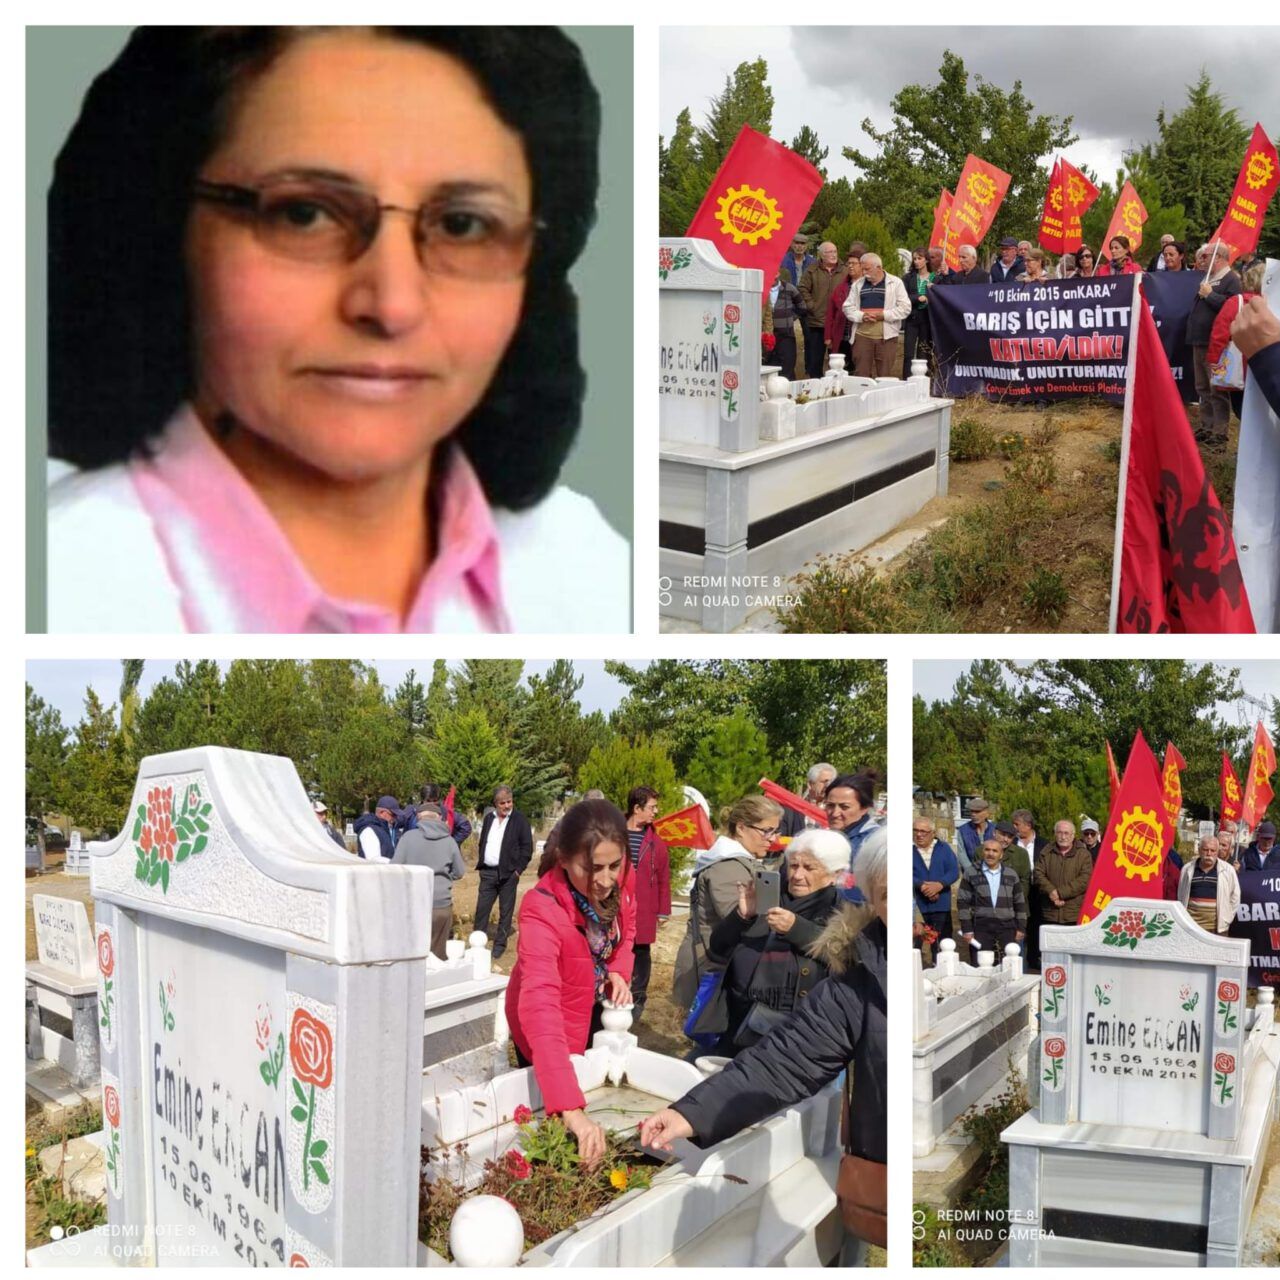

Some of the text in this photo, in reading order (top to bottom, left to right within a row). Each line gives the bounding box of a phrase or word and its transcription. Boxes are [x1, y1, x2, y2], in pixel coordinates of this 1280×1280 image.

[731, 203, 769, 225] EMEP
[1237, 195, 1258, 214] EMEK
[1007, 290, 1030, 303] Ekim
[1034, 287, 1060, 301] 2015
[963, 311, 1021, 335] BARIŞ
[1026, 307, 1074, 334] İÇİN
[954, 364, 1025, 381] UNUTMADIK,
[1010, 383, 1032, 396] Emek
[1034, 385, 1044, 394] ve
[1047, 382, 1096, 395] Demokrasi
[1085, 1011, 1136, 1049] Emine
[1090, 1064, 1107, 1074] 10
[154, 1041, 204, 1152] Emine
